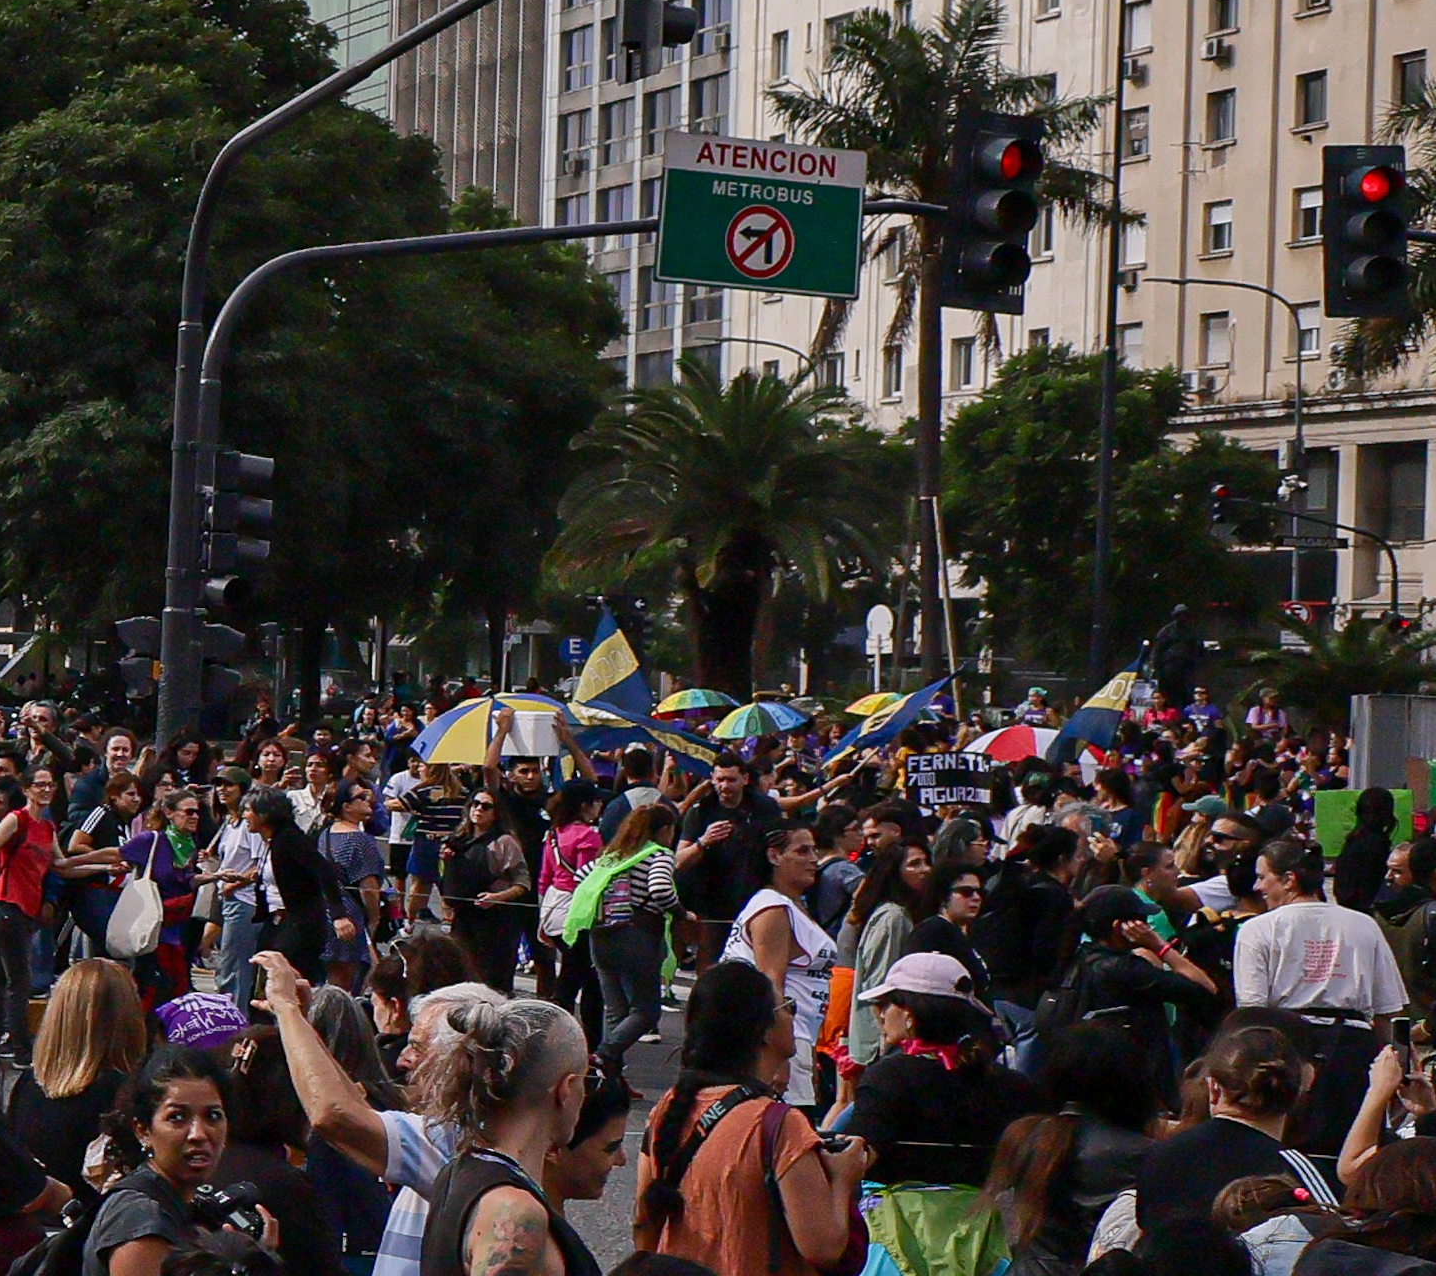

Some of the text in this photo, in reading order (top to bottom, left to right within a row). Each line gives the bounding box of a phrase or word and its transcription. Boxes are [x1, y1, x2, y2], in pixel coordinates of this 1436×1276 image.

[696, 141, 837, 178] ATENCION
[712, 179, 814, 206] METROBUS
[569, 638, 582, 655] E
